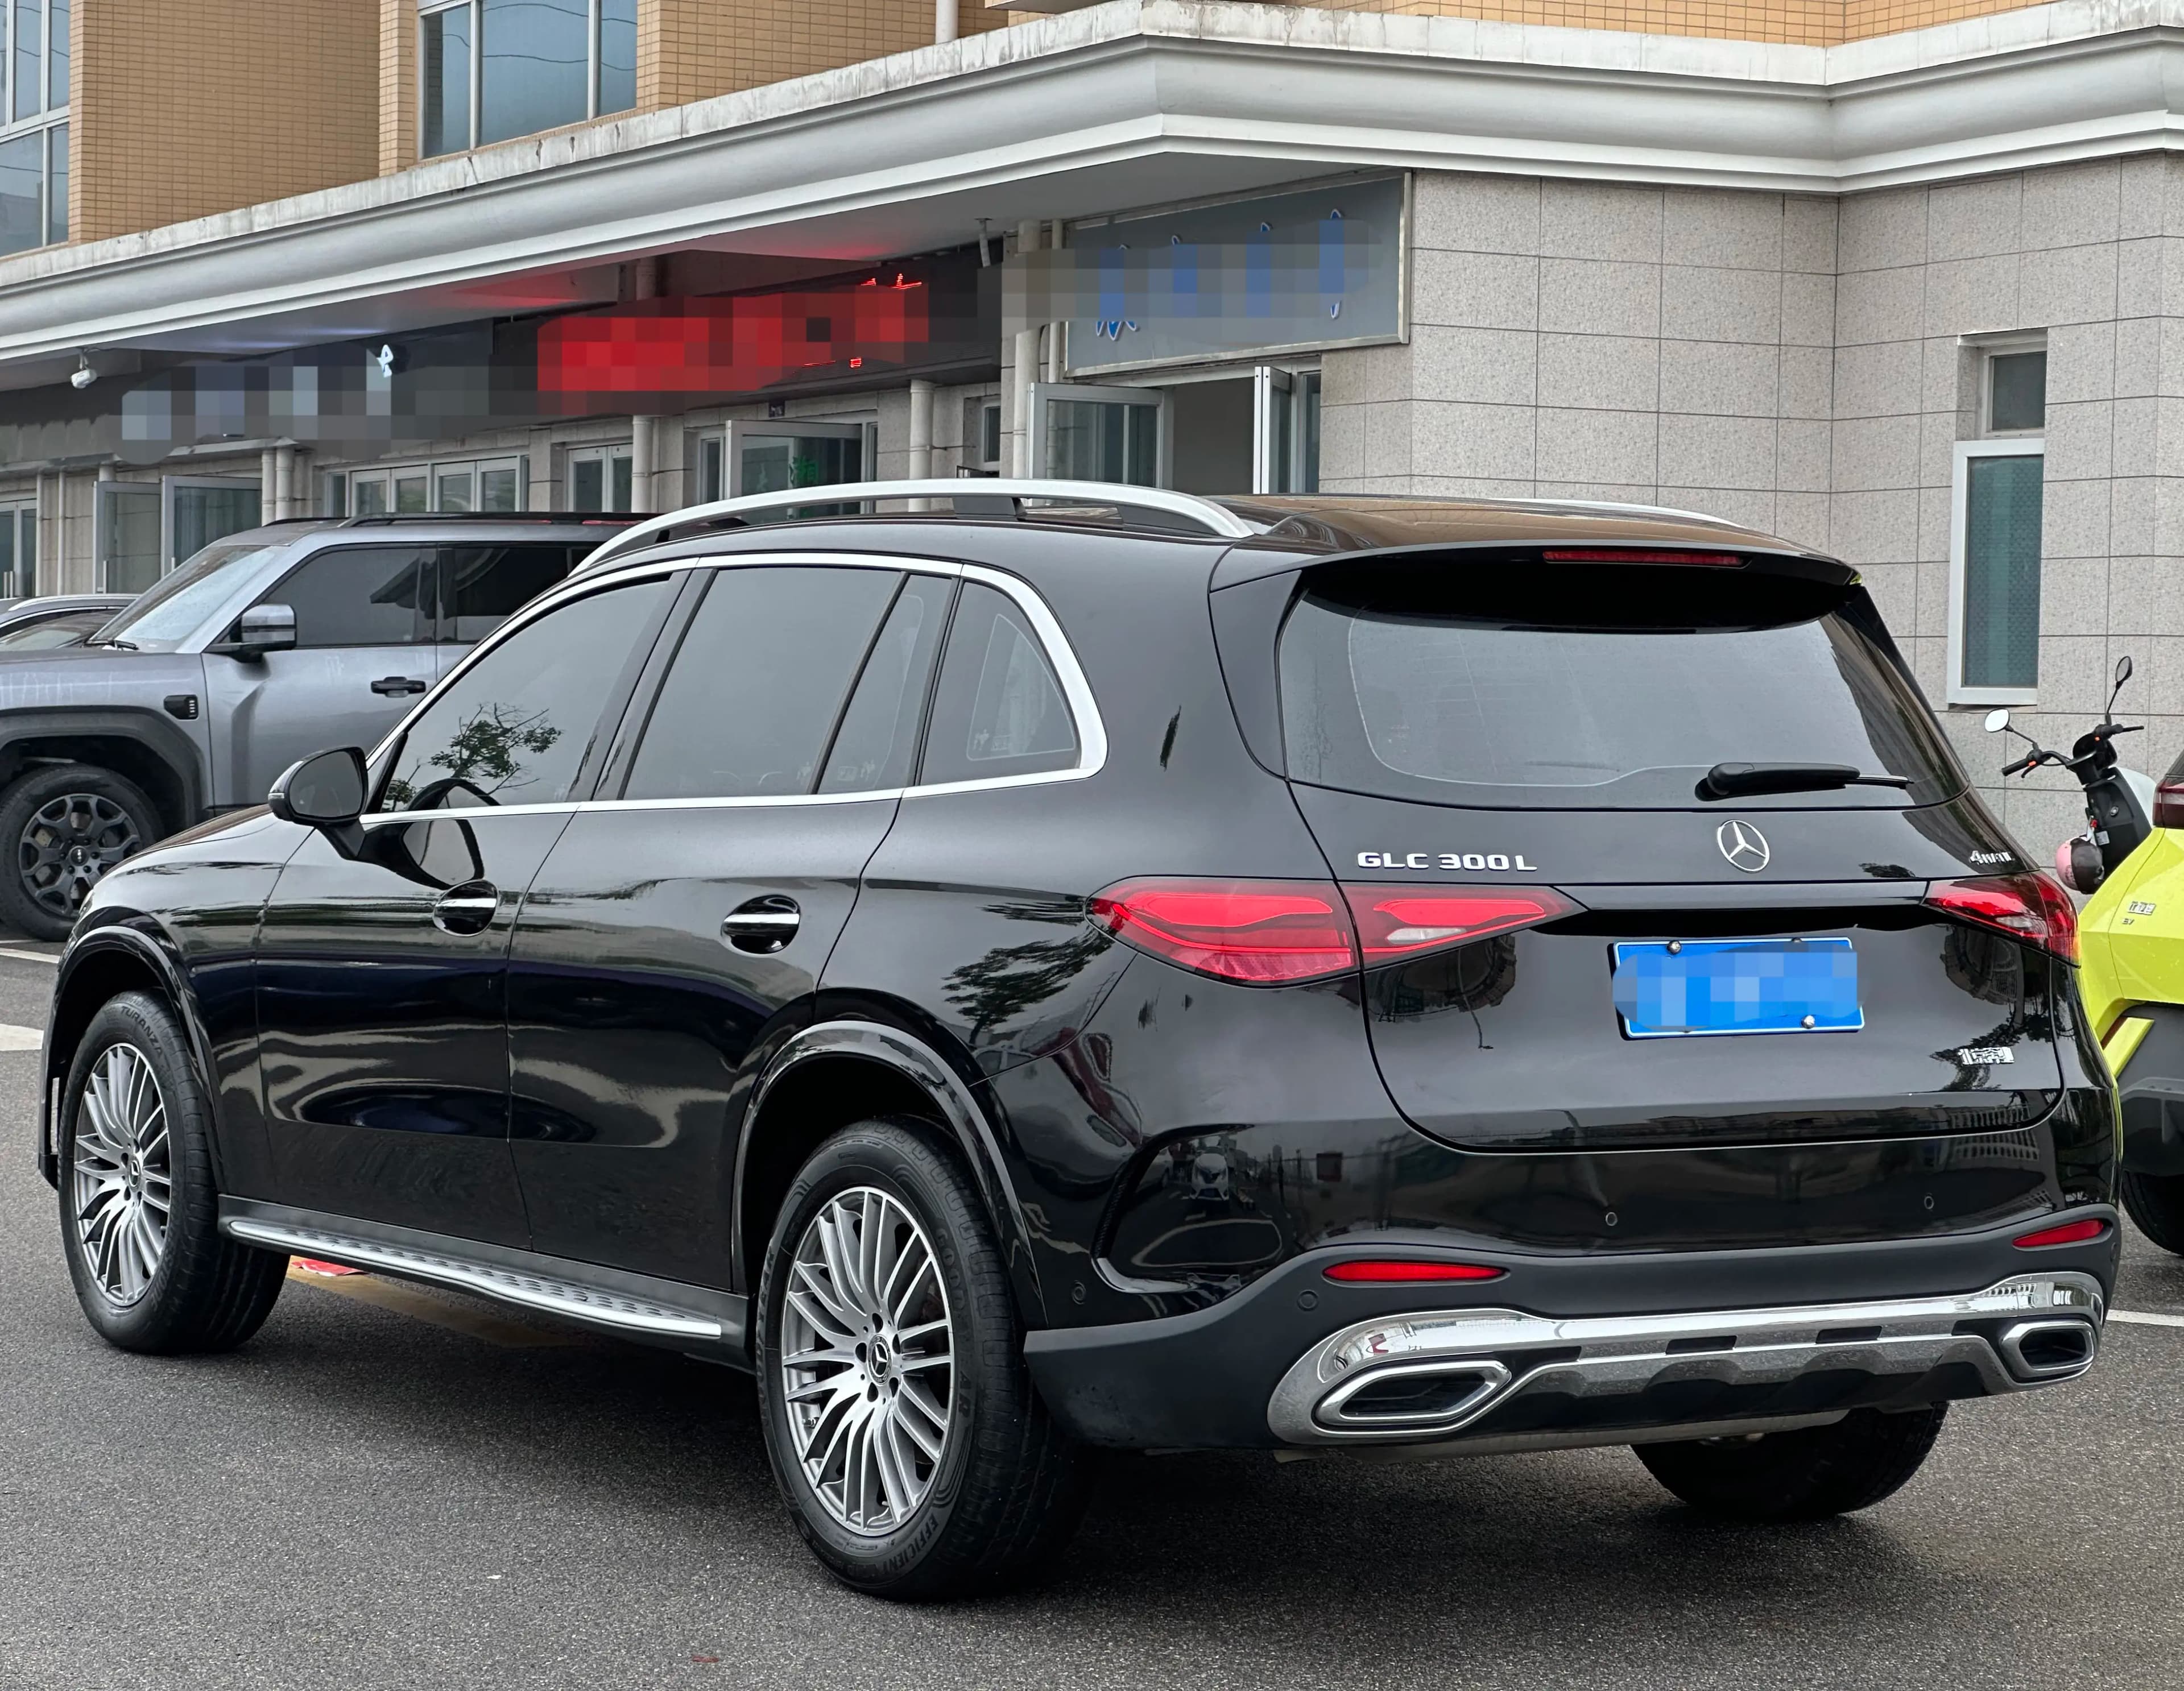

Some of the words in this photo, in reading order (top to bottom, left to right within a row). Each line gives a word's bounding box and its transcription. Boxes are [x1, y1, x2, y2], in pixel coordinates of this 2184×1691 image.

[1357, 852, 1429, 869] GLC
[1438, 853, 1510, 871] 300
[1515, 855, 1538, 871] L
[121, 1006, 163, 1058] TURANZA
[936, 1228, 971, 1418] GOODAR
